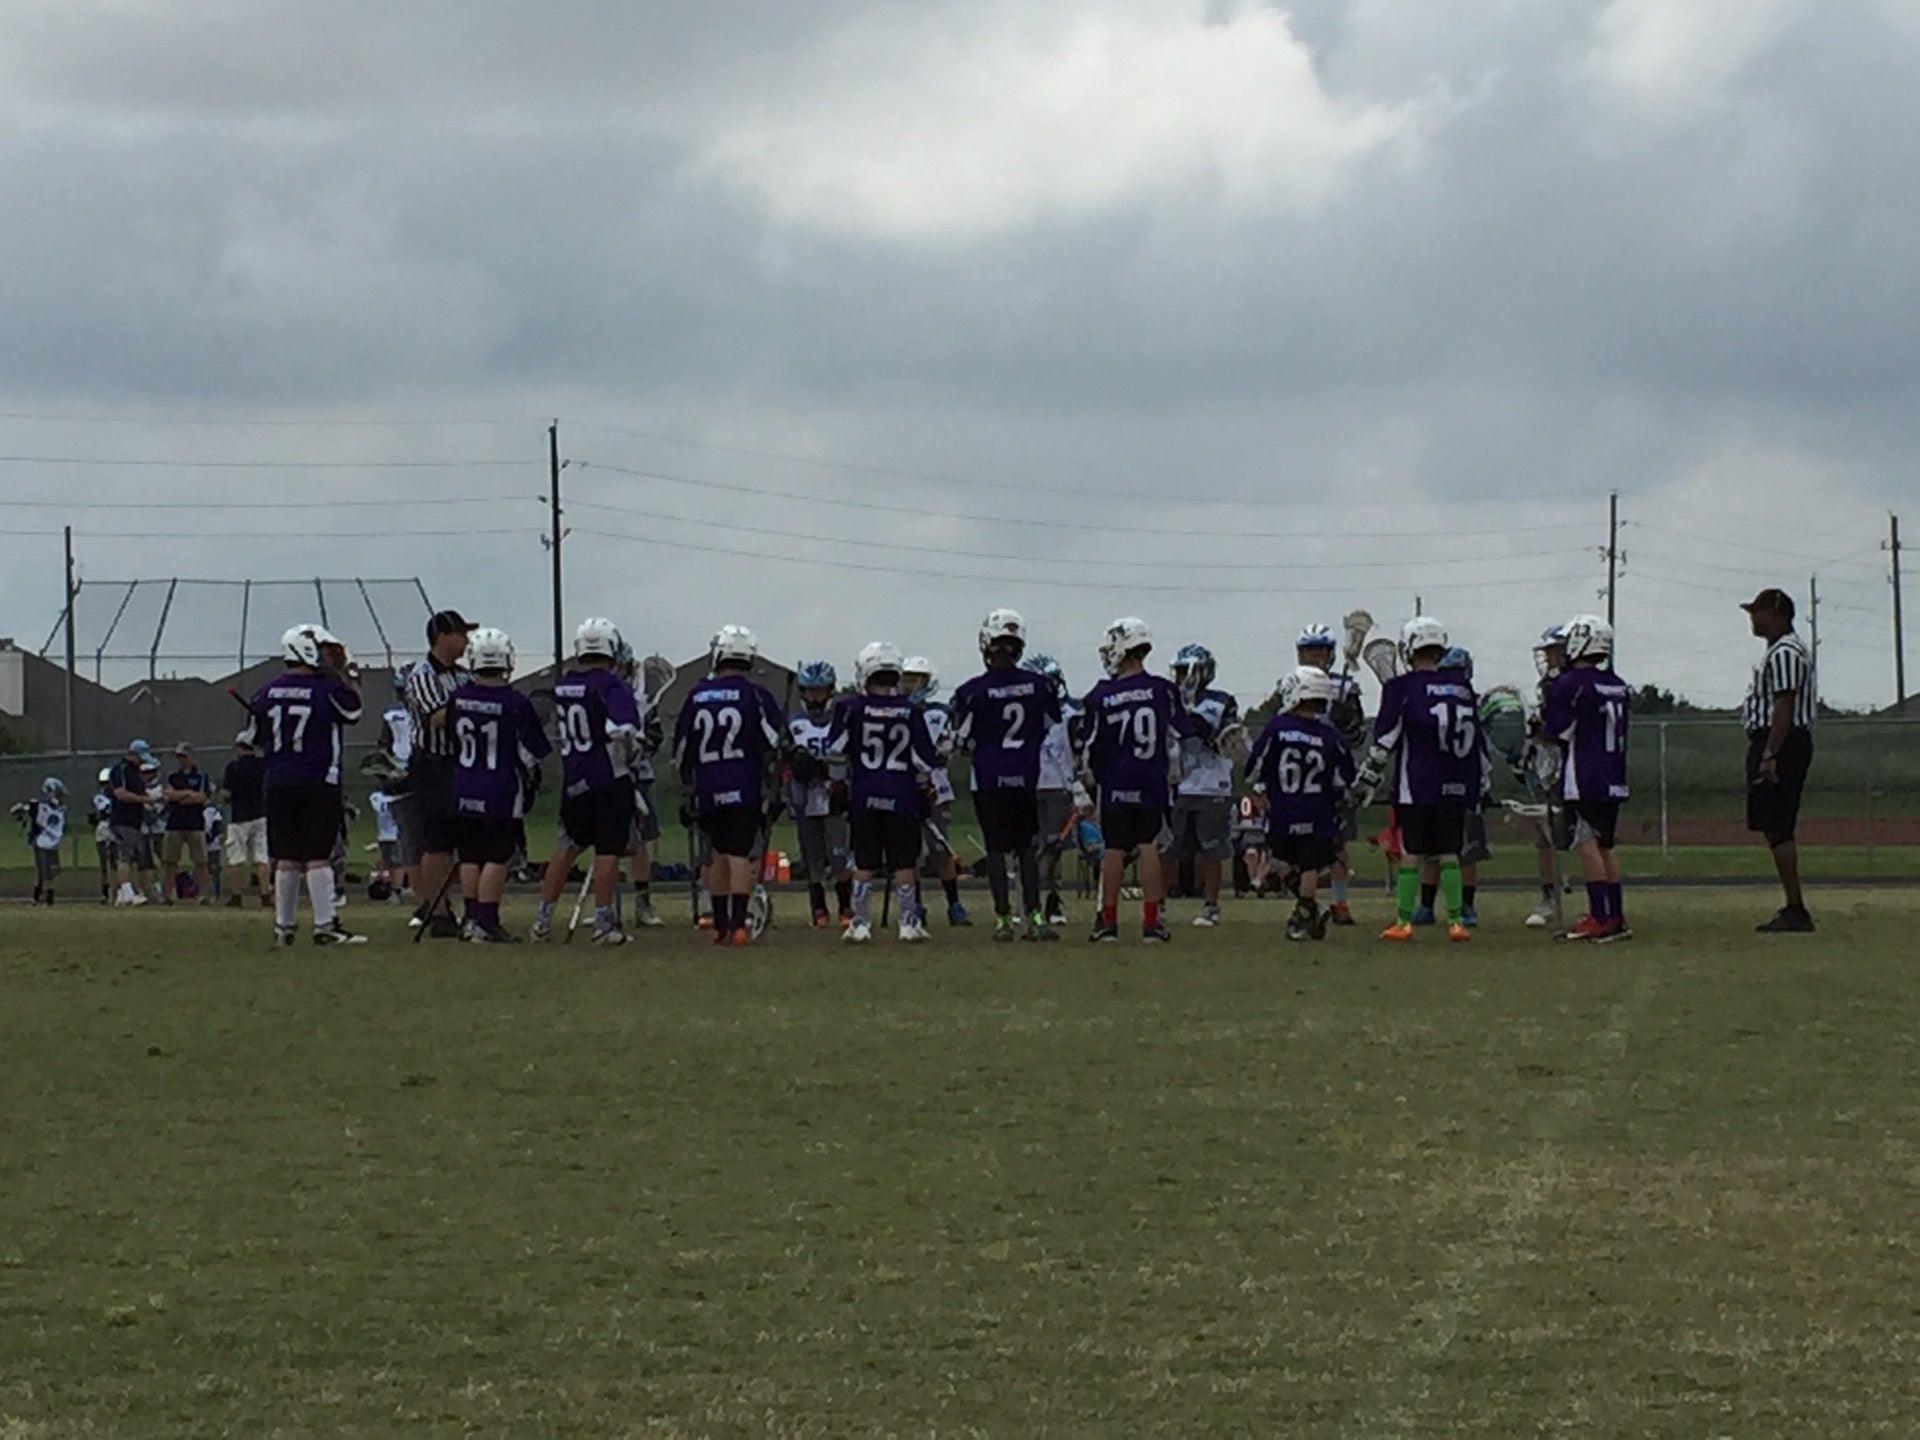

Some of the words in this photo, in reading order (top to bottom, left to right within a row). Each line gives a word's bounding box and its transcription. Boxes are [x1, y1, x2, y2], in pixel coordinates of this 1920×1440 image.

[267, 705, 312, 753] 17
[456, 716, 498, 770] 61
[693, 707, 745, 763] 22
[860, 722, 911, 771] 52
[1002, 702, 1025, 749] 2
[1107, 707, 1156, 760] 79
[1429, 702, 1475, 758] 15
[1278, 746, 1325, 794] 62
